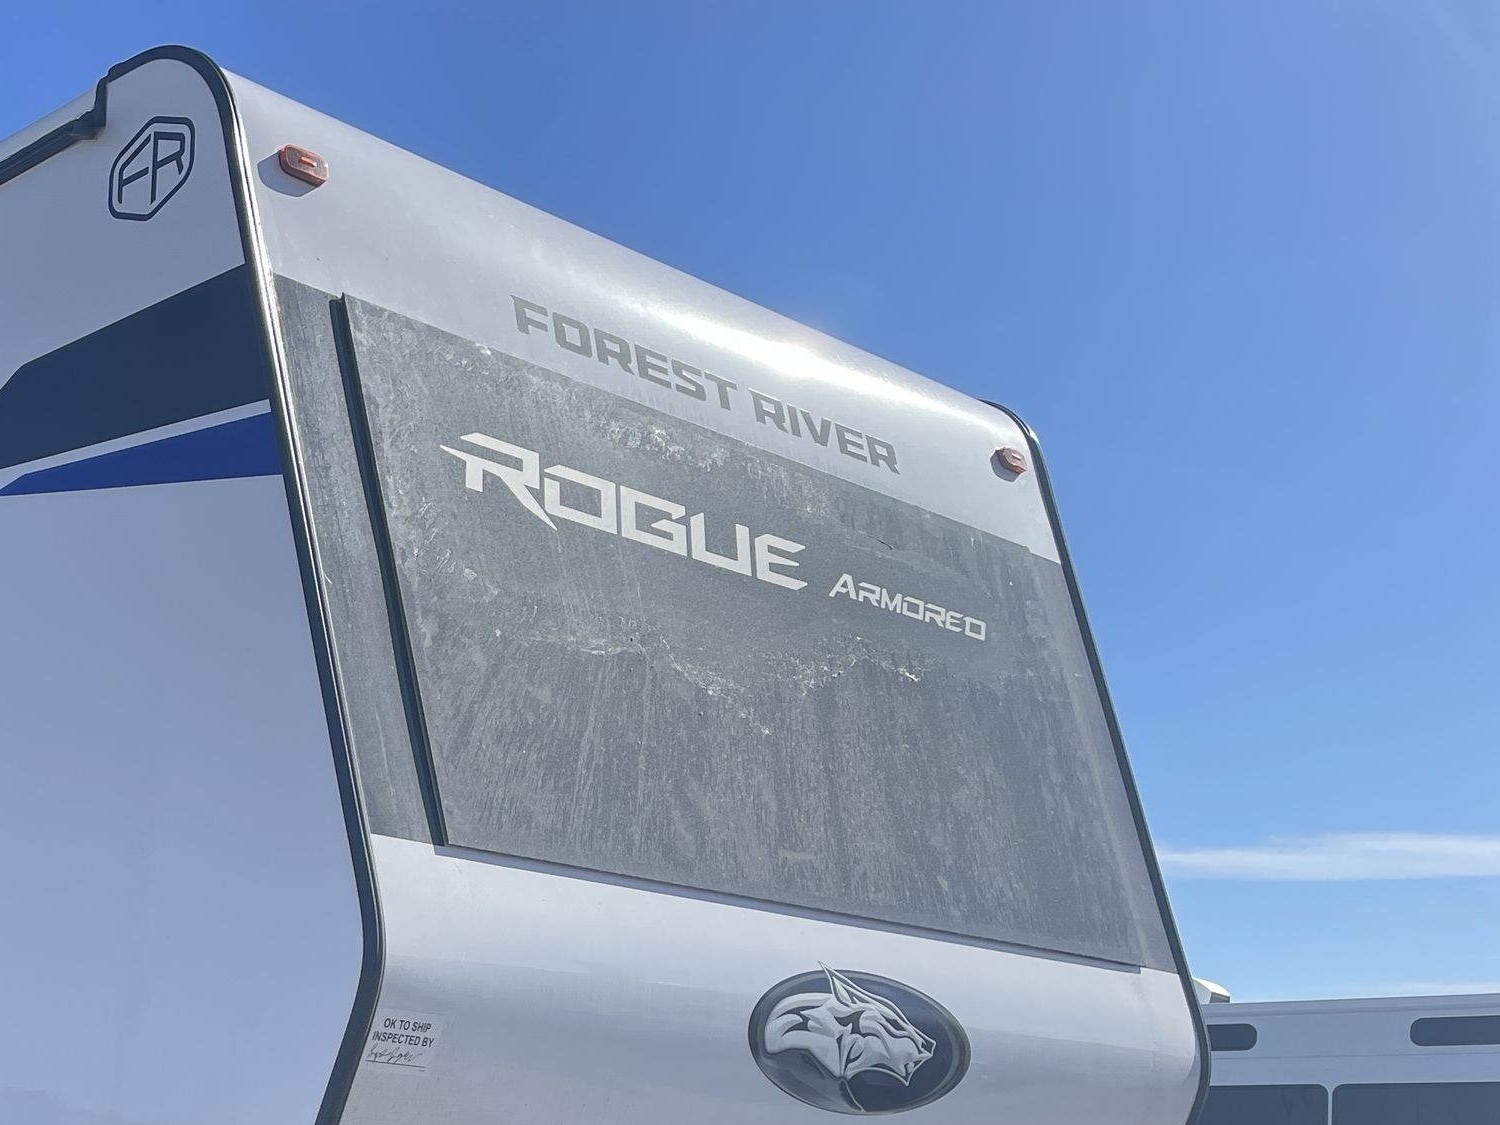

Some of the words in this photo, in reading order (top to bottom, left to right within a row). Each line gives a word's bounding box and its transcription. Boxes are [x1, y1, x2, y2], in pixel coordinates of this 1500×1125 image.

[511, 294, 738, 411] FOREST
[748, 387, 901, 475] RIVER
[440, 432, 808, 591] ROGUE
[829, 573, 987, 641] ARMORED
[372, 1031, 420, 1045] INSPECTED
[422, 1037, 434, 1047] BY
[383, 1018, 397, 1029] OK
[399, 1020, 410, 1030] TO
[412, 1022, 431, 1032] SHIP
